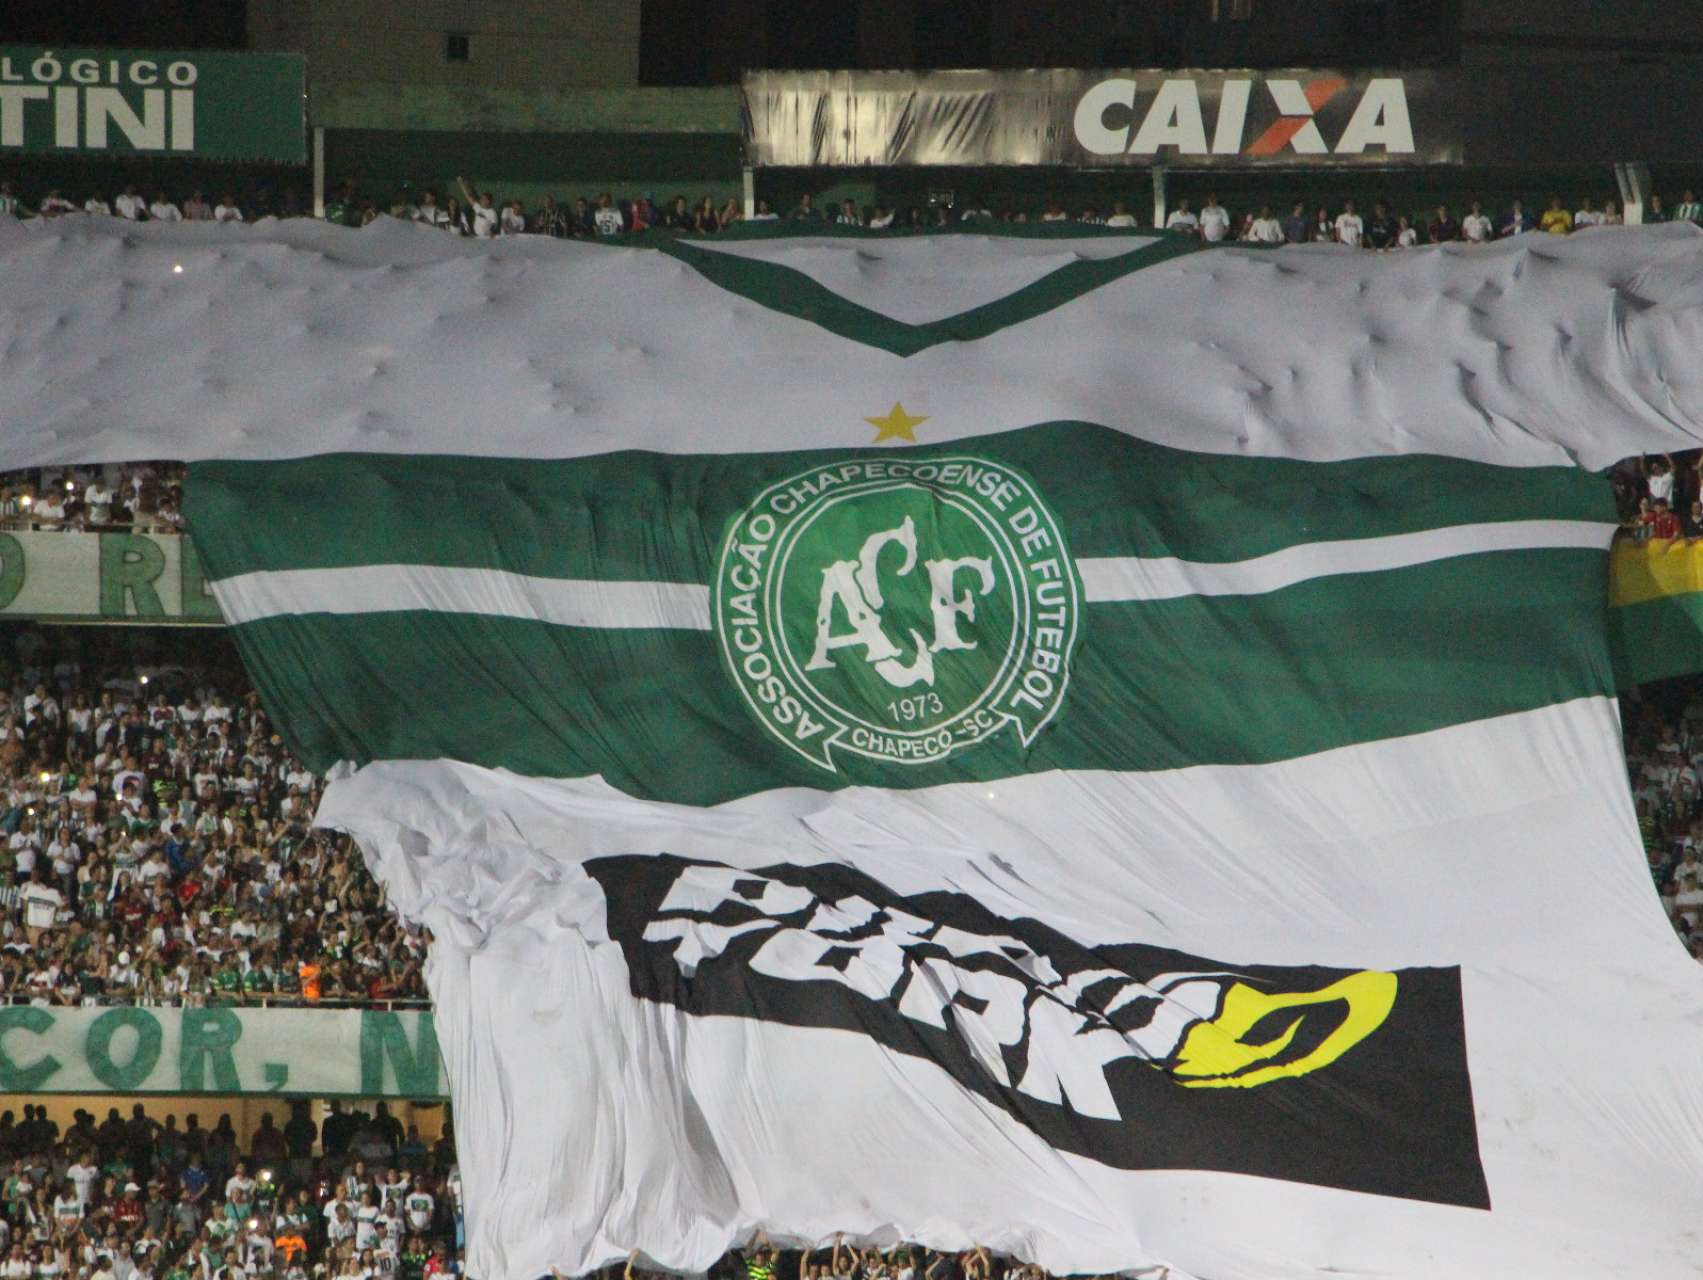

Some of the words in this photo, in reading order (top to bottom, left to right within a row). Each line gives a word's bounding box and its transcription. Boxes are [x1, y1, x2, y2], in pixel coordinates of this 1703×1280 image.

[1073, 78, 1415, 154] CAIXA
[770, 463, 1021, 514] CHAPECOENSE
[1008, 506, 1051, 557] DE
[729, 513, 825, 740] ASSOCIAÇÃO
[1010, 558, 1066, 711] FUTEBOL
[888, 692, 943, 722] 1973
